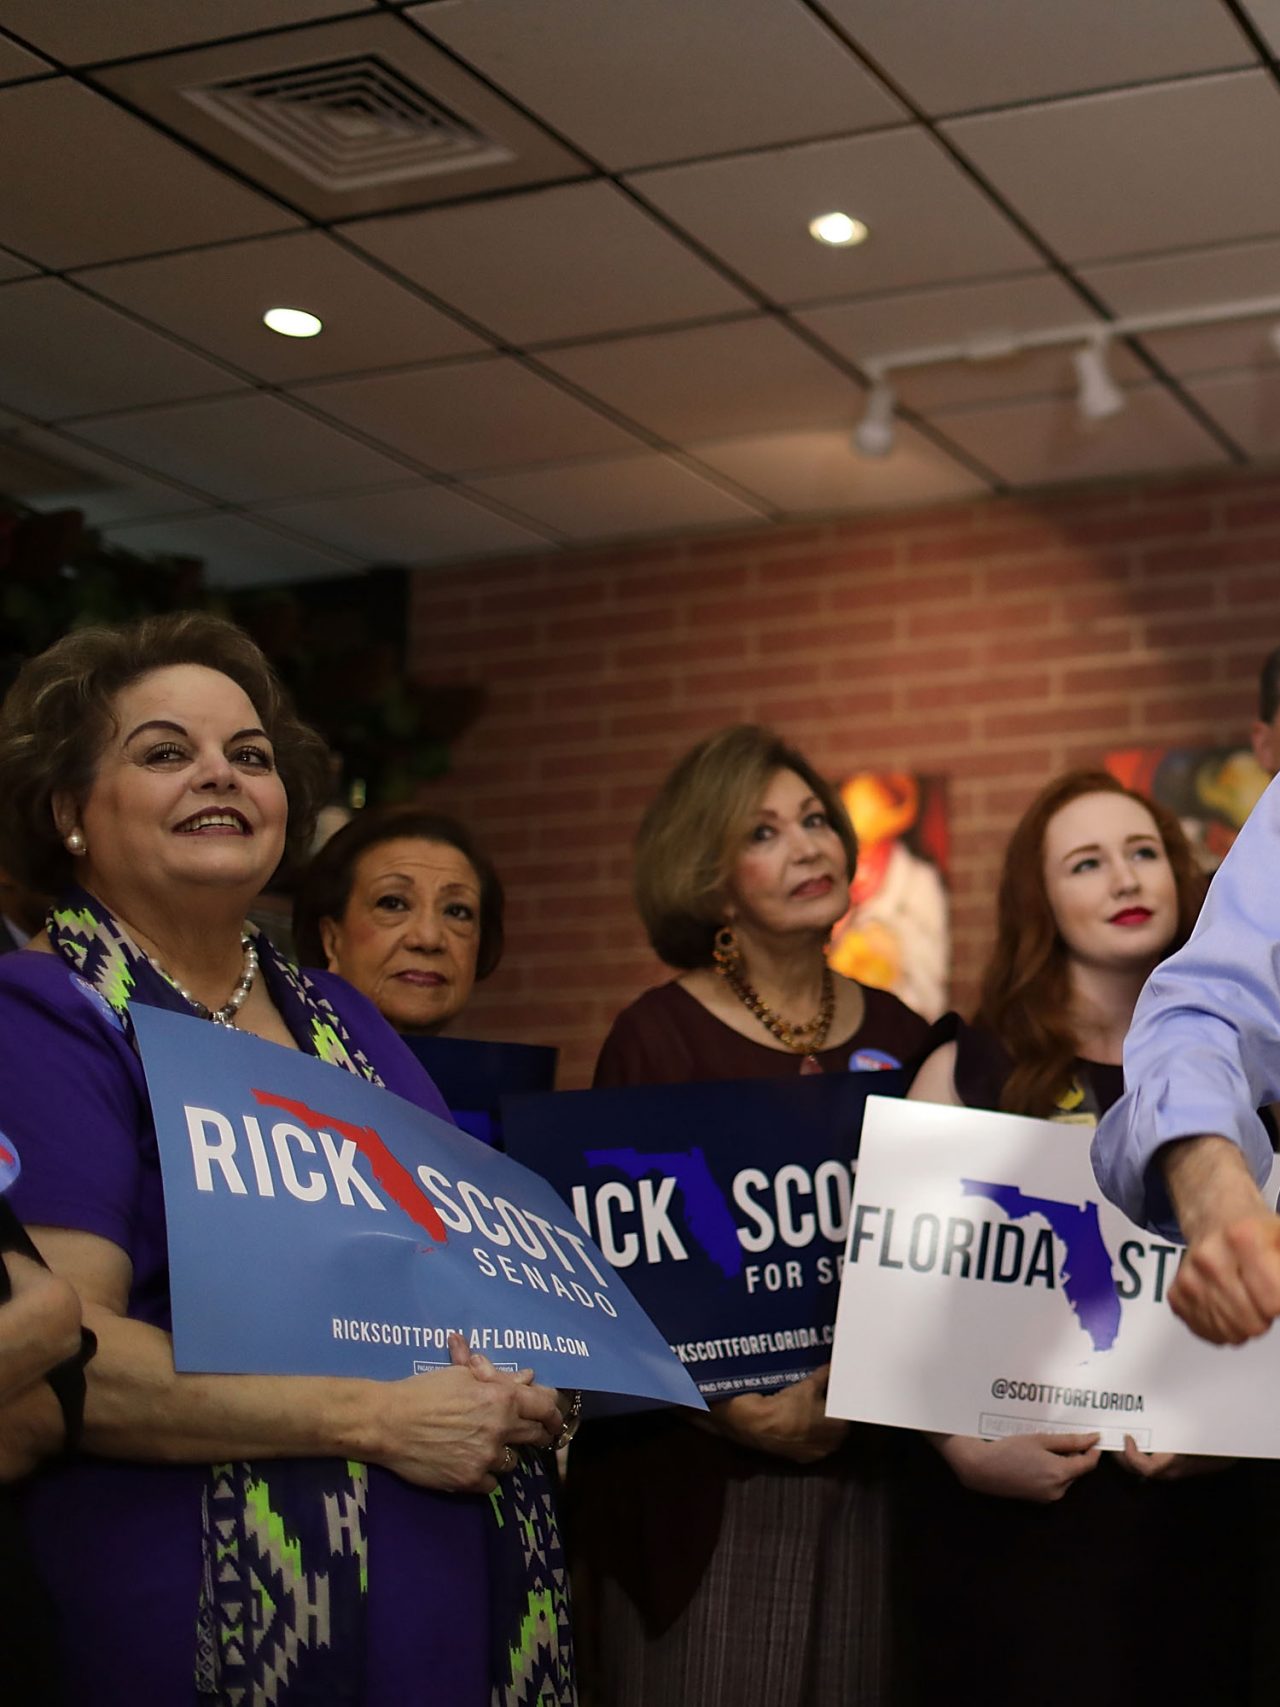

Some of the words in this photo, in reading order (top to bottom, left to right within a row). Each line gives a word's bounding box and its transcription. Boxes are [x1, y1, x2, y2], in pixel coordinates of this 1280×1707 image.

[184, 1105, 387, 1211] RICK
[417, 1165, 608, 1288] SCOTT
[572, 1176, 689, 1268] ICK
[732, 1159, 858, 1253] SCO
[849, 1204, 1057, 1290] FLORIDA
[472, 1248, 618, 1318] SENADO
[745, 1260, 803, 1293] FOR
[332, 1318, 590, 1357] RICKSCOTTPOAFLORIDA.COM
[669, 1325, 834, 1363] KSCOTTFORFLORIDA.C
[991, 1378, 1145, 1412] @SCOTTFORFLORIDA
